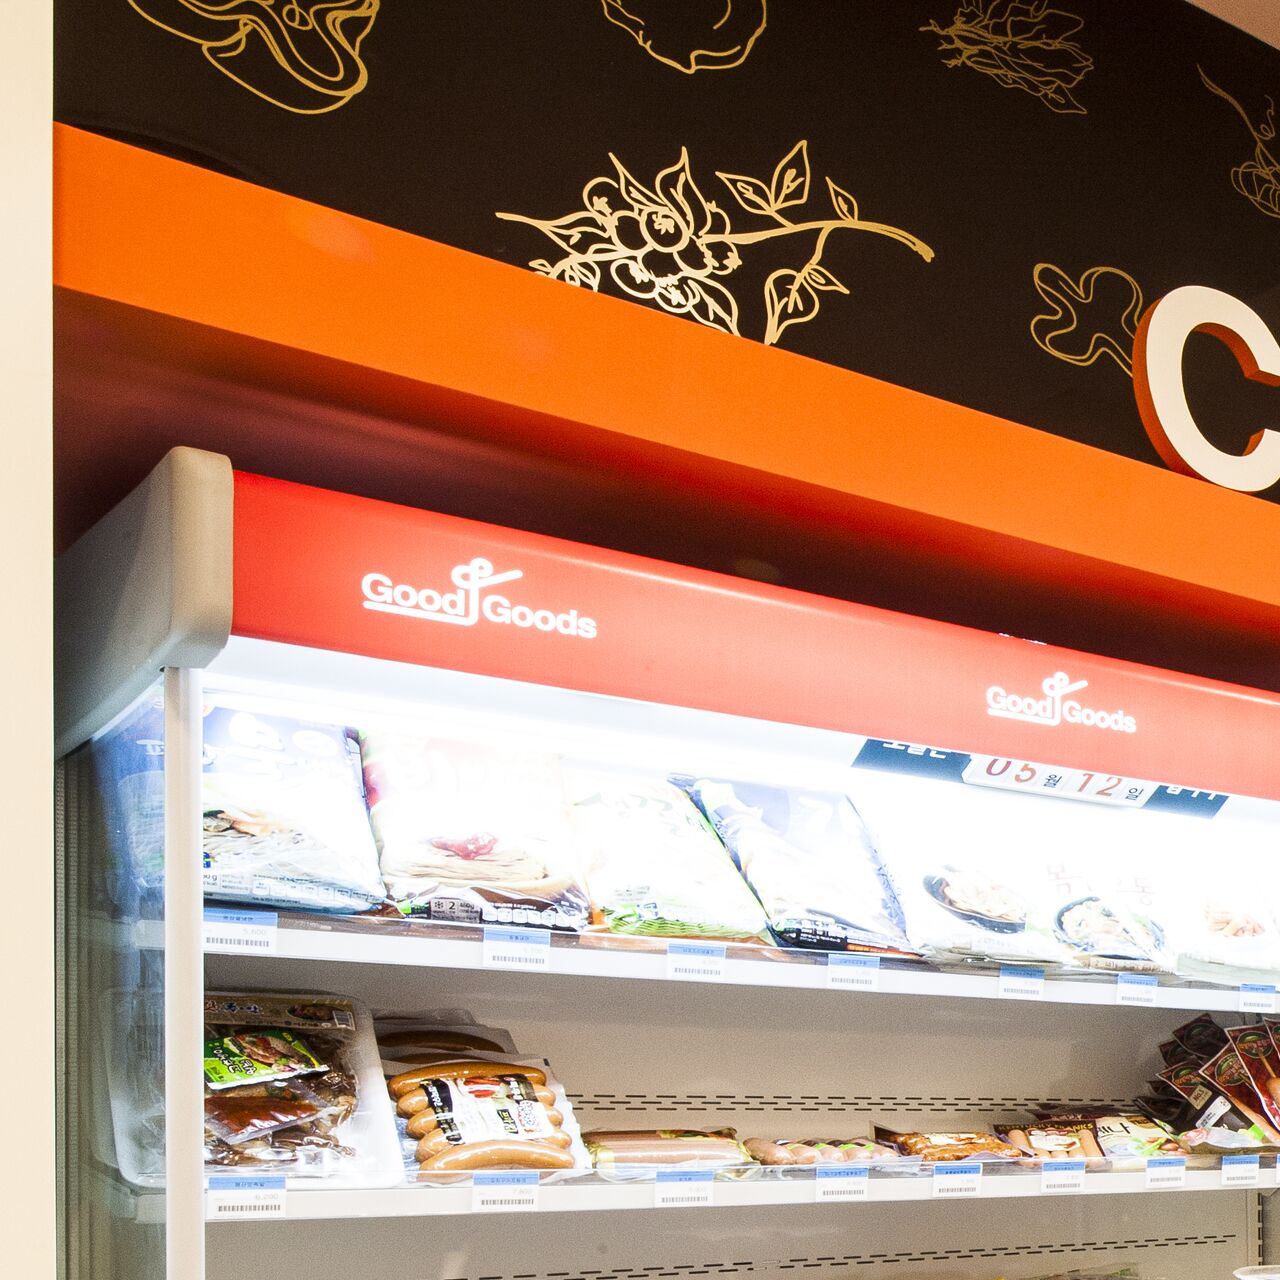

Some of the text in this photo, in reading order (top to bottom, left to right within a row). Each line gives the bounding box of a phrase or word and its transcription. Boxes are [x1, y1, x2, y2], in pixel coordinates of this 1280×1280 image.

[361, 573, 598, 639] Good Goods
[986, 685, 1136, 733] Good Goods
